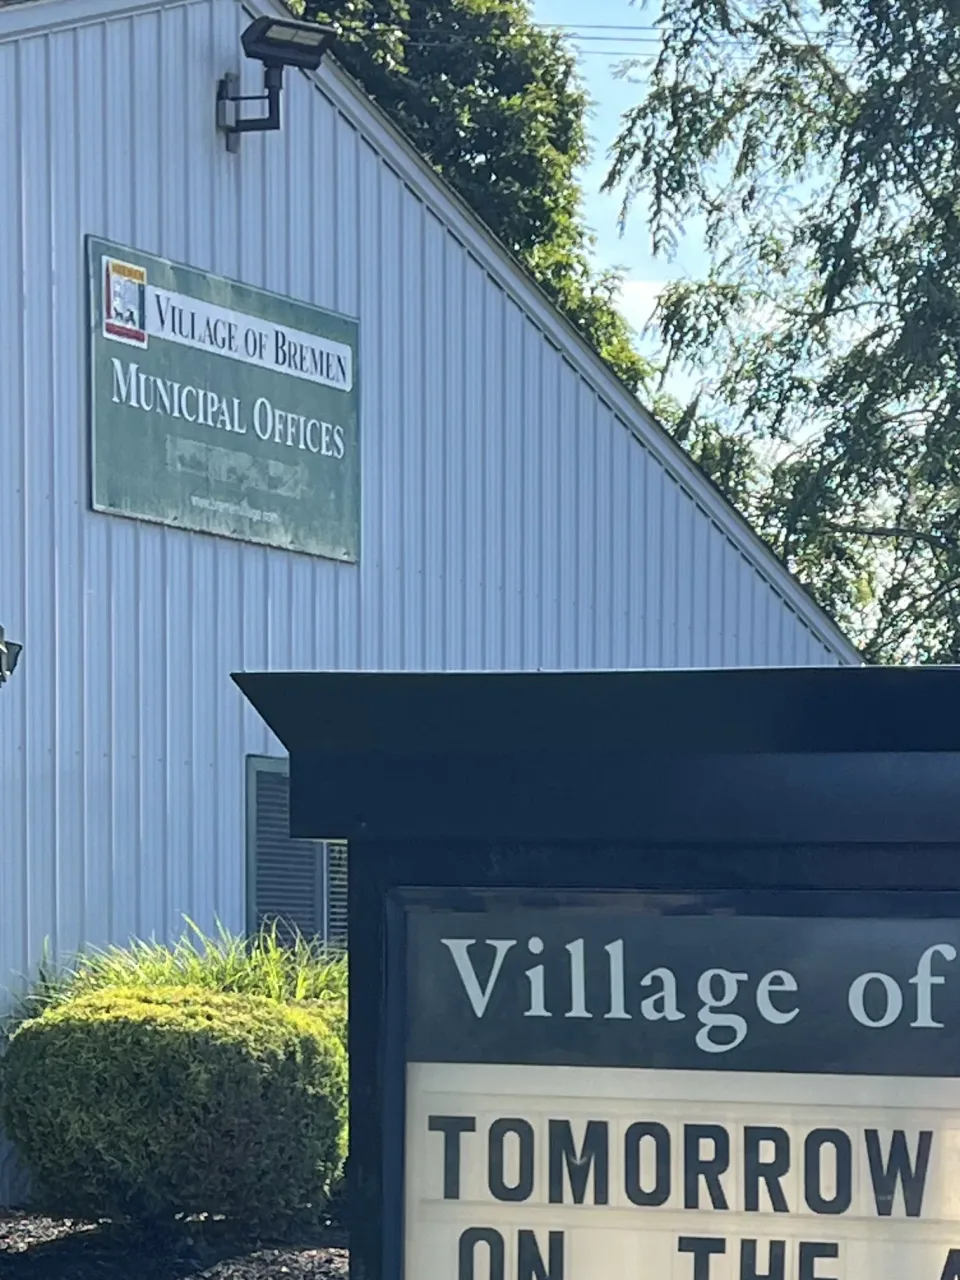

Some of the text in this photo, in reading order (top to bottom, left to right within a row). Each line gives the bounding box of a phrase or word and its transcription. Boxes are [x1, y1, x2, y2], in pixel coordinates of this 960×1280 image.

[154, 293, 347, 384] VILLAGE OF BREMEN
[111, 356, 345, 459] MUNICIPAL OFFICES
[441, 937, 799, 1053] Village
[849, 944, 956, 1027] of
[428, 1115, 932, 1218] TOMORROW
